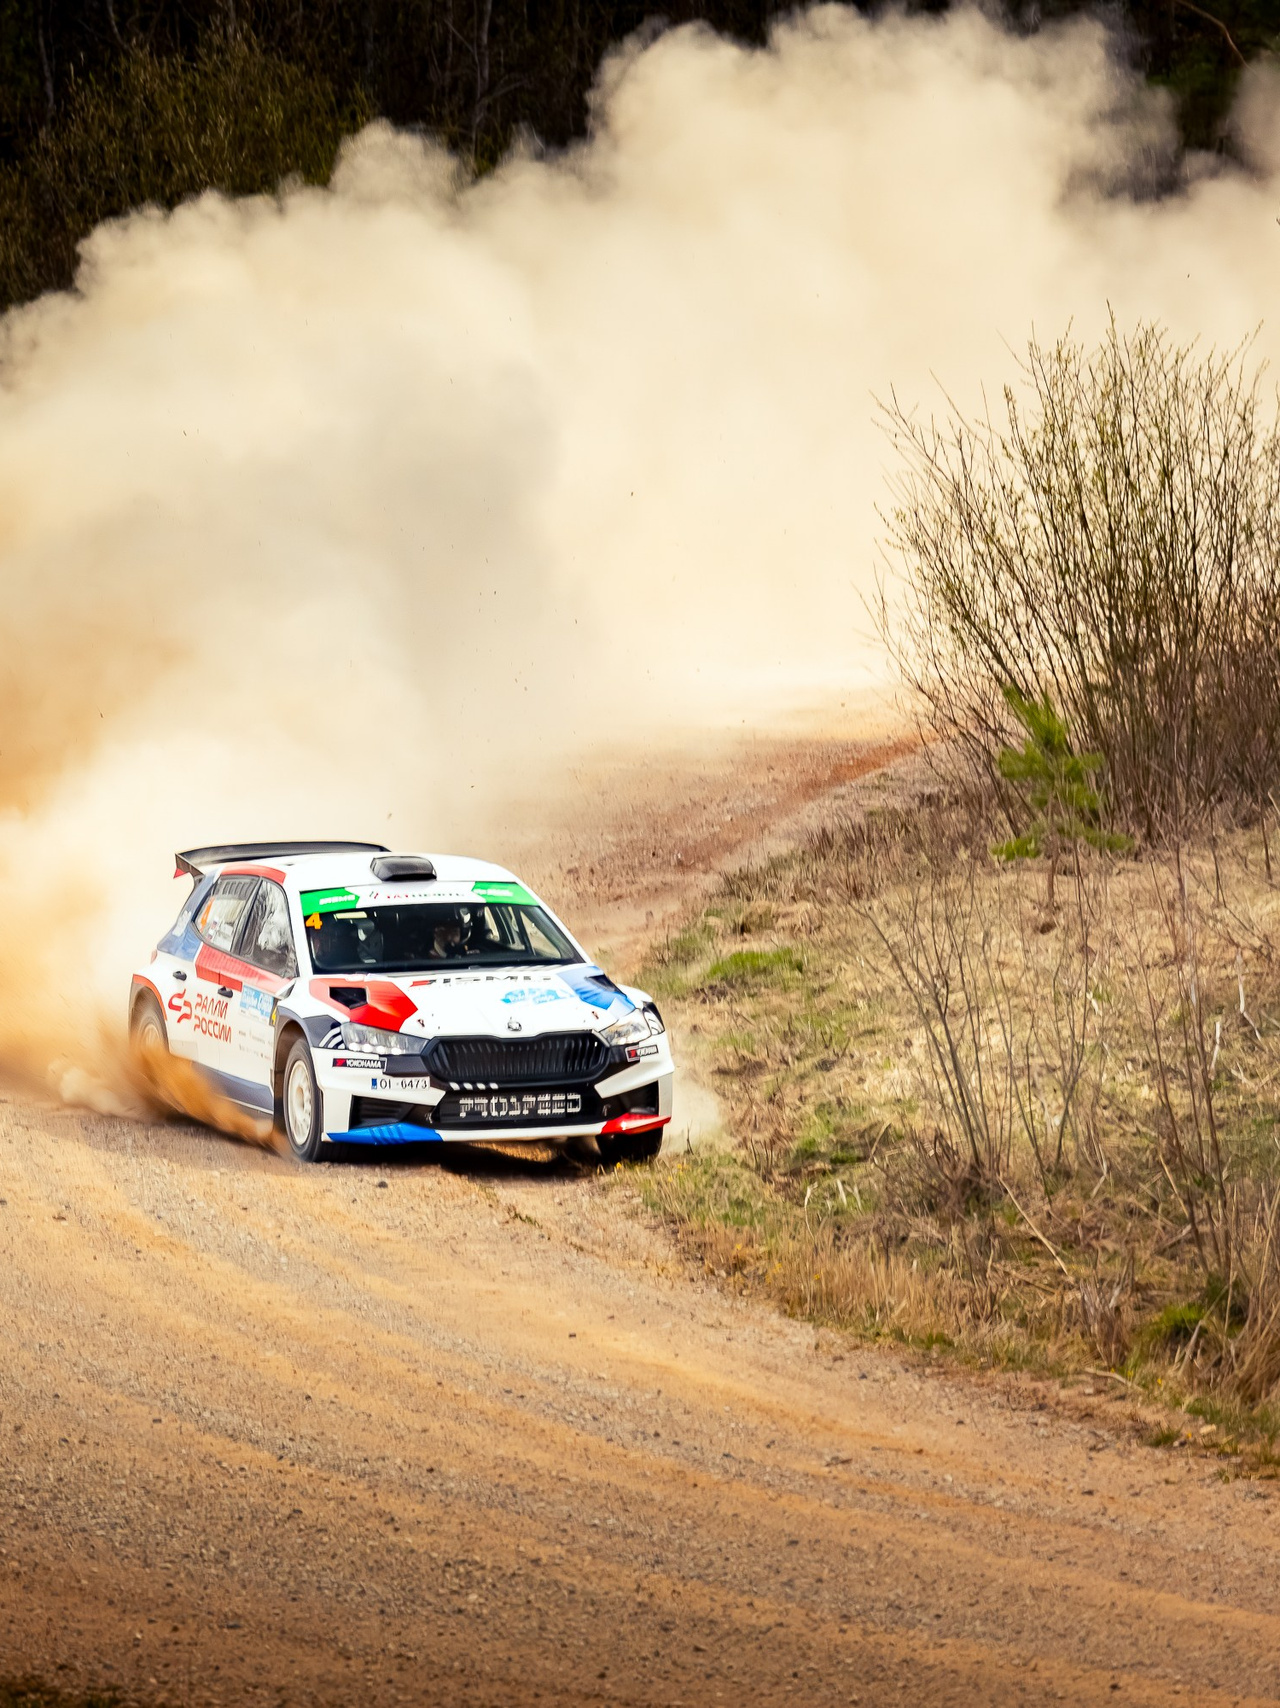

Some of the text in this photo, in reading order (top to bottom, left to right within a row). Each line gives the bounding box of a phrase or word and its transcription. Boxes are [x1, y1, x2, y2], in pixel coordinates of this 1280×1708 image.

[305, 911, 323, 929] 4
[195, 993, 229, 1021] РАЛЛИ
[194, 1014, 231, 1044] РОССИИ
[346, 1058, 382, 1069] YOKOHAMA
[459, 1092, 582, 1118] PROSPEED
